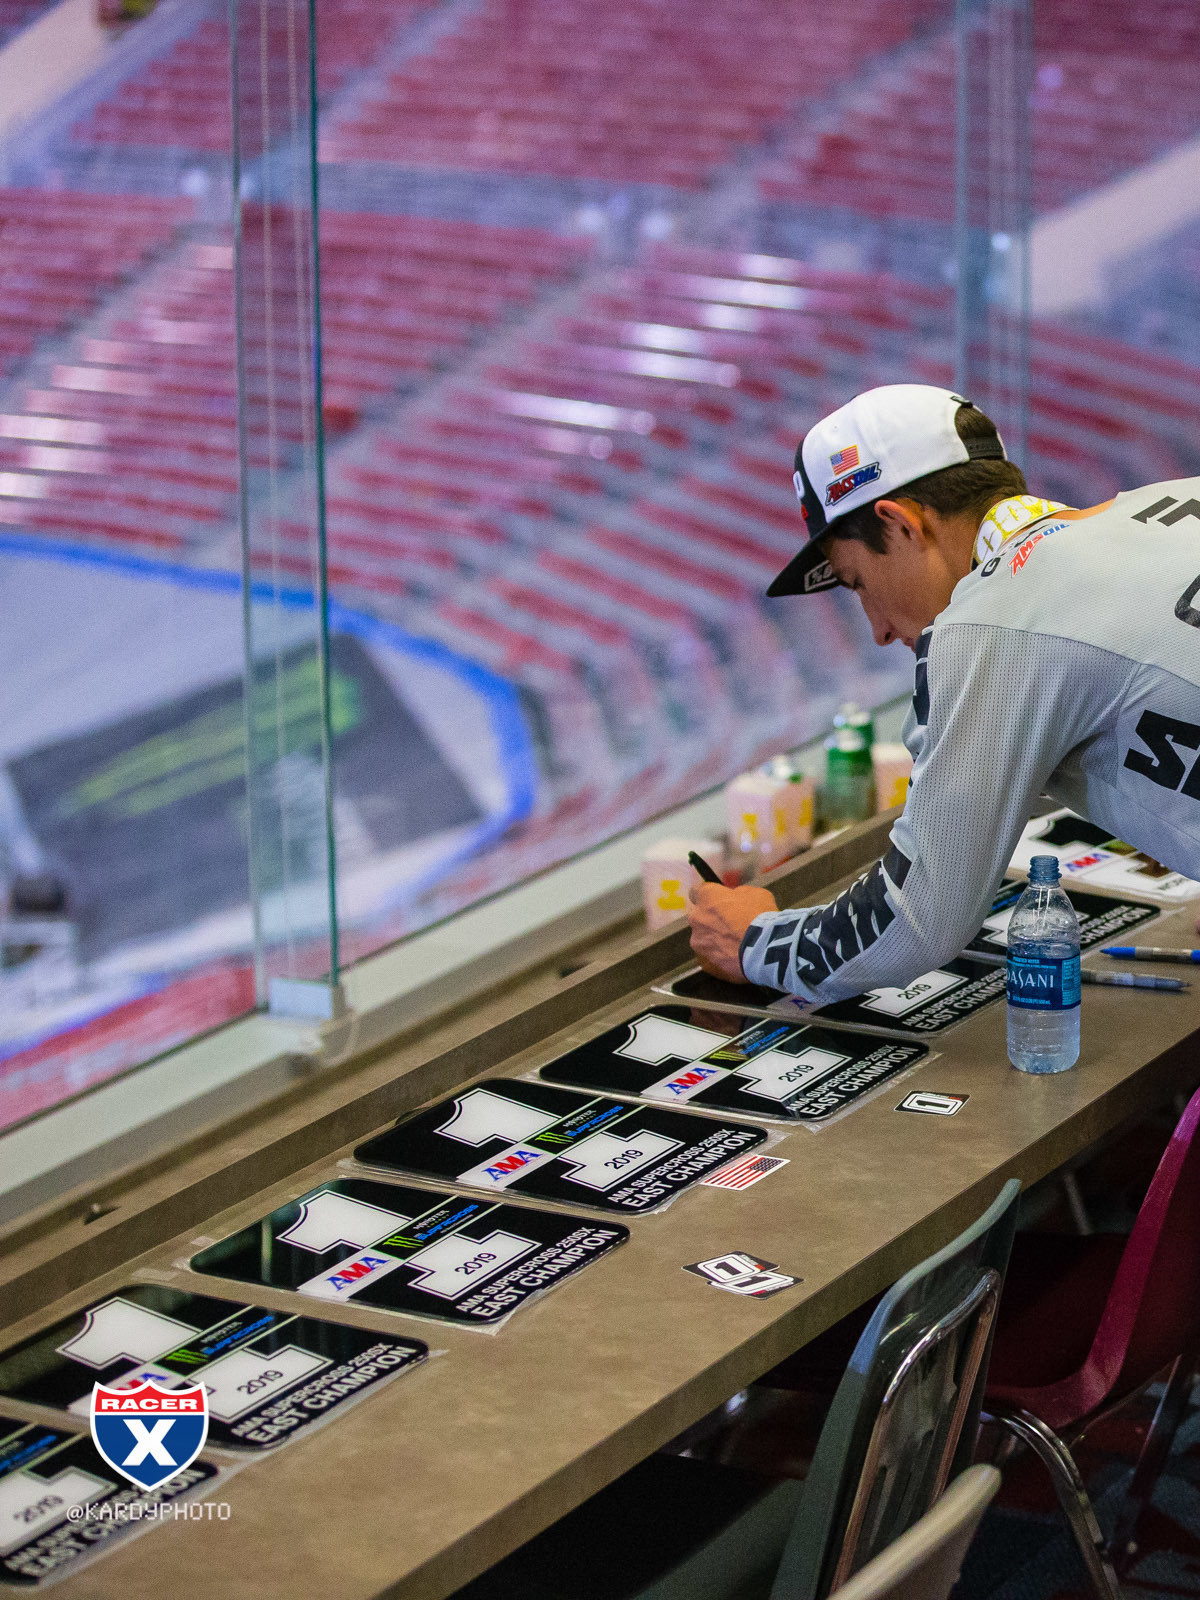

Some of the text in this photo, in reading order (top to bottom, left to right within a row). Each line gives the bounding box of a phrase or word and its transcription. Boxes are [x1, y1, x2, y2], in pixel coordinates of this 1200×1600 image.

[827, 464, 880, 503] AMSOIL
[1009, 523, 1070, 576] AMSOIL
[897, 983, 932, 1000] 2019
[1006, 968, 1054, 989] ASANI
[902, 1013, 930, 1027] AMA
[922, 981, 986, 1015] SUPERCROSS
[915, 976, 1008, 1030] EAST CHAMP
[664, 1067, 718, 1095] AMA
[778, 1064, 814, 1083] 2019
[786, 1044, 897, 1112] AMA SUPERCROSS 250SX
[800, 1046, 919, 1115] EAST CHAMPION
[482, 1150, 542, 1181] AMA
[604, 1149, 643, 1170] 2019
[607, 1128, 736, 1203] AMA SUPERCROSS 250SX
[621, 1131, 758, 1207] EAST CHAMPION
[325, 1256, 390, 1291] AMA
[454, 1252, 497, 1275] 2019
[455, 1226, 597, 1312] AMA SUPERCROSS 250SX
[470, 1229, 620, 1317] EAST CHAMPION
[714, 1261, 743, 1276] 1
[230, 1416, 269, 1437] AMA
[261, 1365, 354, 1418] SUPERCROSS
[237, 1370, 284, 1395] 2019
[246, 1345, 417, 1442] EAST CHAMPION
